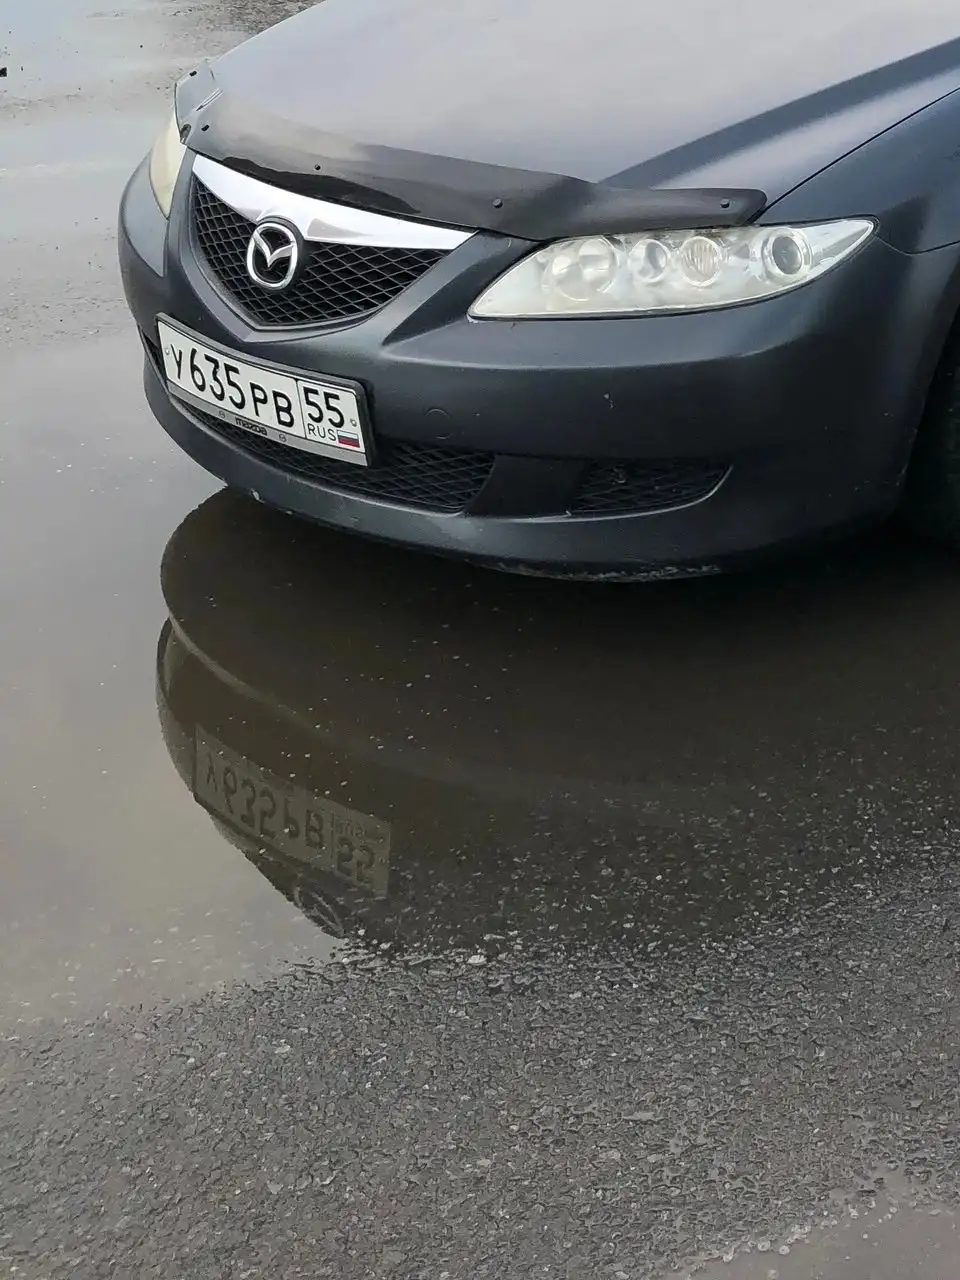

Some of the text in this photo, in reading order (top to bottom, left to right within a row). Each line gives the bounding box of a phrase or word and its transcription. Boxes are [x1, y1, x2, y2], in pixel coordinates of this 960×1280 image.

[170, 343, 345, 428] У635РВ 55
[307, 423, 337, 442] RUS
